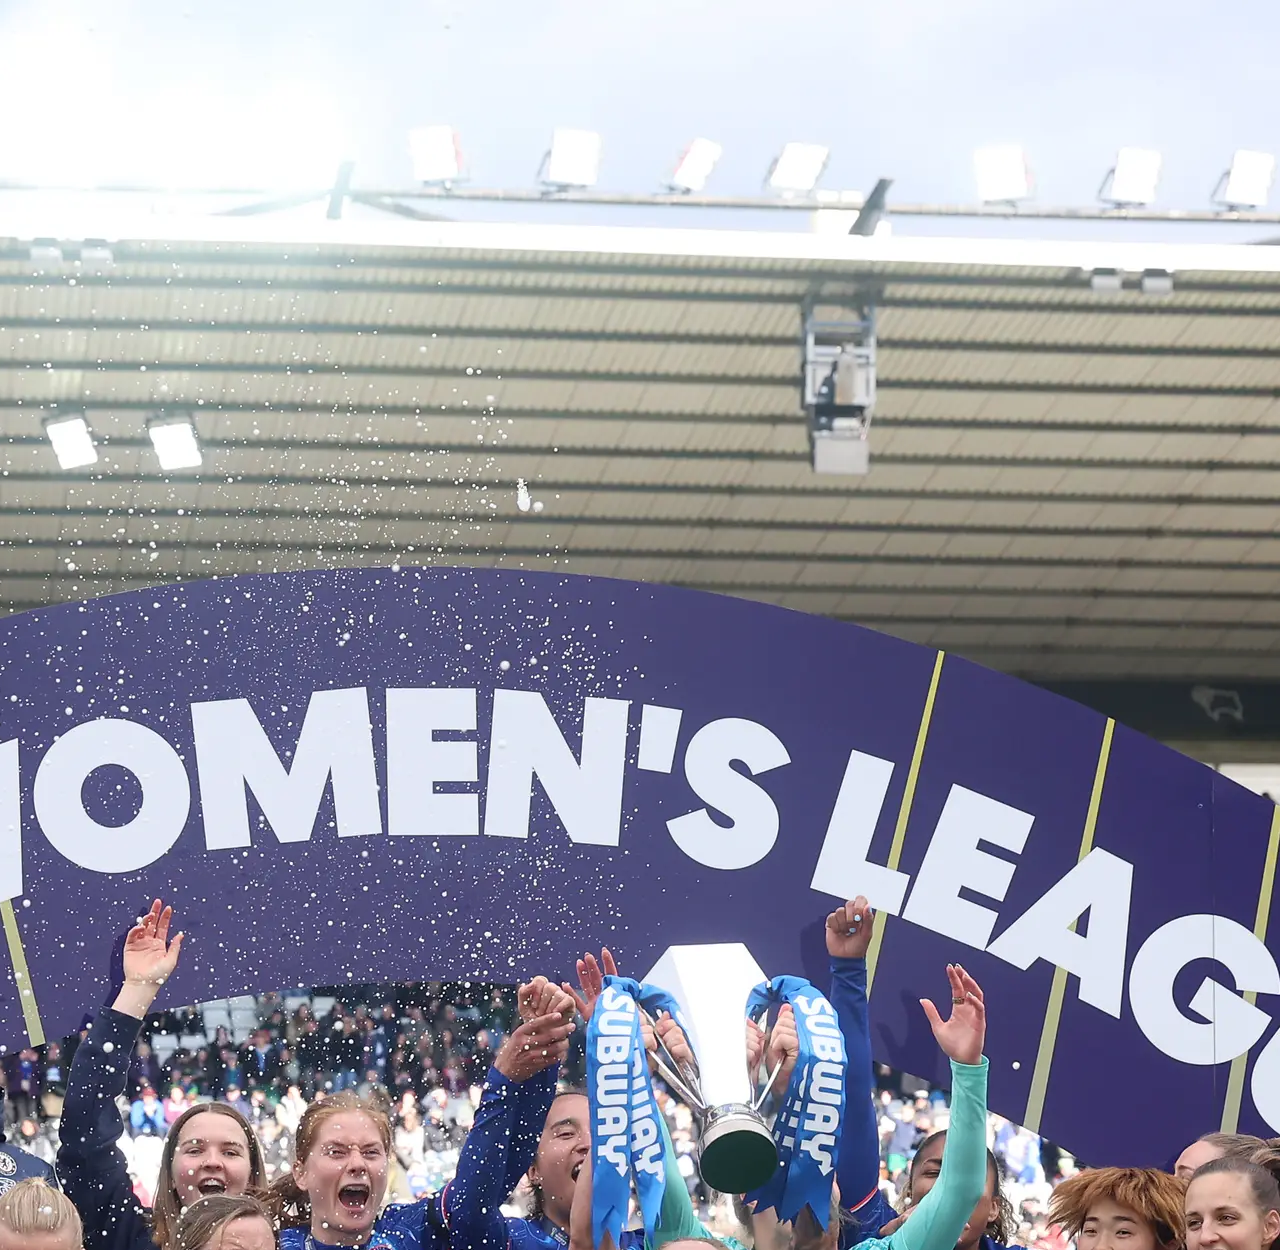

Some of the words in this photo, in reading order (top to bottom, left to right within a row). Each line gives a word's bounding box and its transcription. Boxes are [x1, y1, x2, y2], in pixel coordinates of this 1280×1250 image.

[596, 986, 636, 1177] SUBWAY
[631, 1040, 665, 1183] WAY
[793, 995, 845, 1177] SUBWAY
